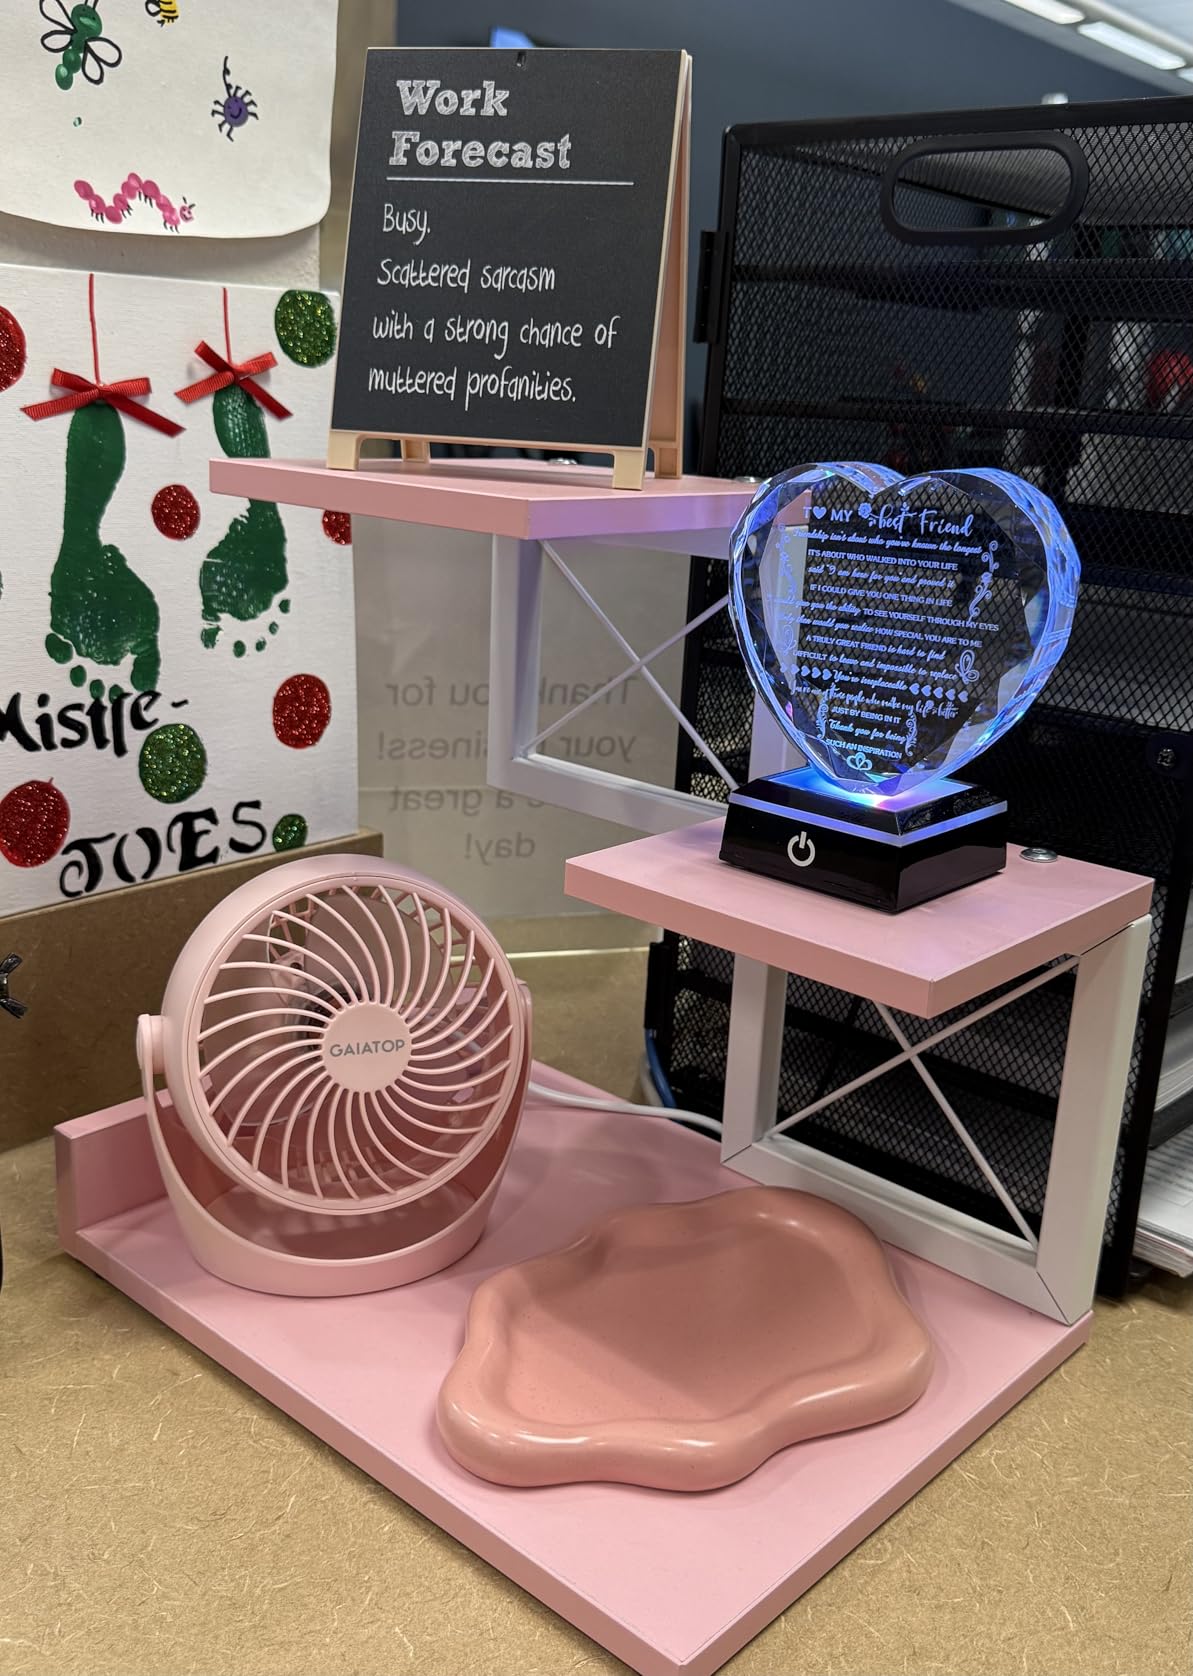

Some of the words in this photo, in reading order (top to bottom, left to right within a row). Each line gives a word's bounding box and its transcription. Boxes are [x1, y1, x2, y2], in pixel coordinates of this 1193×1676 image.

[396, 80, 510, 116] Work
[388, 131, 572, 169] Forecast
[382, 203, 431, 245] Busy.
[377, 258, 471, 293] Scattered
[480, 265, 556, 292] sarcasm
[372, 310, 413, 340] with
[424, 317, 434, 343] a
[445, 314, 508, 360] strong
[519, 317, 583, 347] chance
[594, 315, 621, 348] of
[368, 366, 457, 401] muttered
[465, 365, 576, 411] profanities.
[830, 509, 853, 522] MY
[919, 508, 974, 537] Friend
[938, 541, 953, 551] the
[821, 550, 846, 559] ABOUT
[847, 553, 865, 561] WHO
[866, 555, 896, 564] WALKED
[897, 558, 917, 567] INTO
[918, 560, 940, 569] YOUR
[940, 562, 958, 570] LIFE
[821, 585, 846, 594] COULD
[847, 588, 865, 597] GIVE
[866, 590, 882, 598] YOU
[883, 593, 899, 601] ONE
[901, 594, 925, 603] THING
[935, 599, 953, 607] LIFE
[863, 608, 873, 616] TO
[874, 609, 888, 617] SEE
[888, 611, 926, 622] YOURSELF
[927, 616, 965, 627] THROUGH
[978, 622, 999, 631] EYES
[813, 635, 835, 645] TRULY
[835, 639, 860, 648] GREAT
[860, 643, 887, 652] FRIEND
[874, 627, 893, 636] HOW
[894, 630, 923, 640] SPECIAL
[924, 634, 941, 642] YOU
[941, 636, 957, 645] ARE
[970, 640, 982, 648] ME
[793, 650, 827, 660] DIFFICULT
[831, 706, 849, 715] JUST
[850, 709, 860, 717] BY
[860, 711, 884, 721] BEING
[893, 716, 902, 724] IT
[826, 739, 846, 749] SUCH
[846, 743, 857, 751] AN
[857, 745, 902, 759] INSPIRATION
[59, 800, 266, 897] TOES
[329, 1039, 405, 1057] GAIATOP
